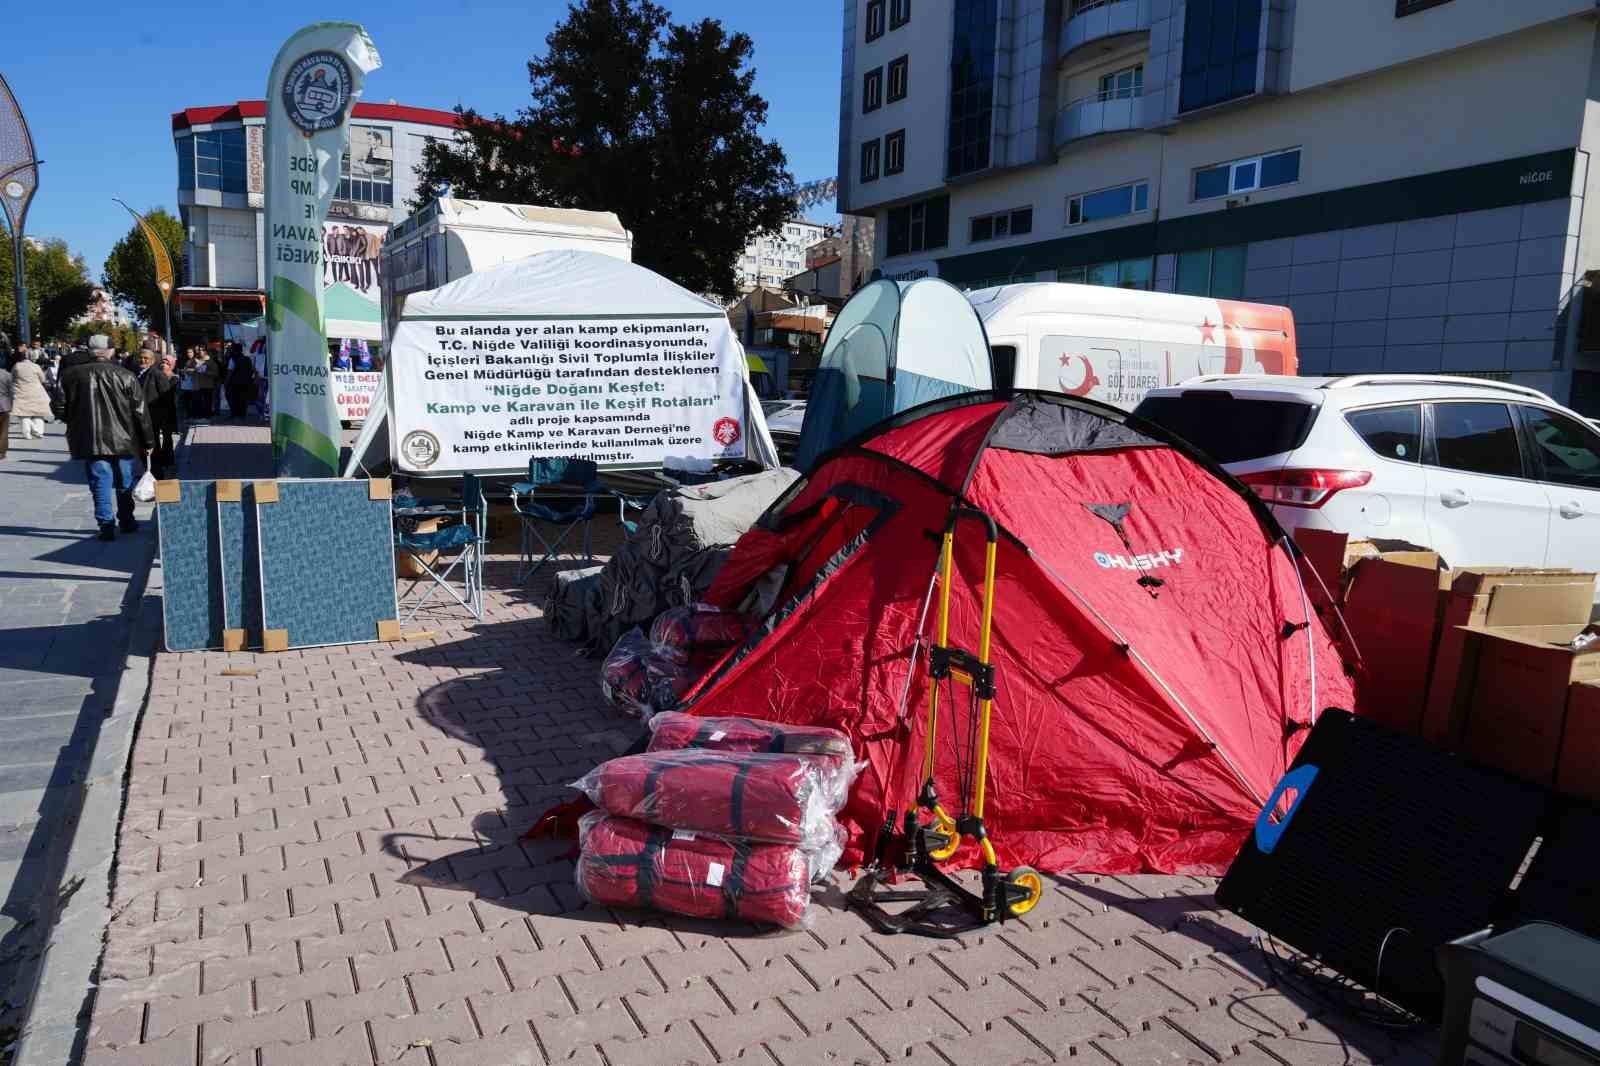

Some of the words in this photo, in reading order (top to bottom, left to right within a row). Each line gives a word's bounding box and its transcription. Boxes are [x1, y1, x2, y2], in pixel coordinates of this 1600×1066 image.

[435, 326, 455, 336] Bu
[460, 325, 510, 335] alanda
[516, 327, 538, 336] yer
[543, 325, 574, 334] alan
[579, 325, 618, 335] kamp
[622, 323, 709, 334] ekipmanları,
[439, 340, 467, 350] T.C.
[472, 340, 515, 352] Niğde
[520, 339, 570, 351] Valiliği
[575, 337, 708, 349] koordinasyonunda,
[428, 353, 479, 367] İçişleri
[485, 355, 554, 366] Bakanlığı
[559, 353, 589, 364] Sivil
[594, 352, 659, 364] Toplumla
[663, 350, 715, 363] İlişkiler
[425, 369, 468, 380] Genel
[474, 369, 551, 380] Müdürlüğü
[556, 367, 629, 378] tarafından
[634, 365, 720, 376] desteklenen
[547, 383, 603, 396] Doğanı
[608, 381, 665, 395] Keşfet:
[426, 403, 476, 415] Kamp
[482, 404, 501, 412] ve
[507, 401, 575, 412] Karavan
[581, 400, 600, 410] ile
[605, 398, 646, 411] Keşif
[510, 417, 533, 425] adlı
[538, 415, 570, 426] proje
[574, 413, 651, 424] kapsamında
[464, 430, 502, 440] Niğde
[507, 430, 544, 439] Kamp
[568, 427, 620, 436] Karavan
[625, 424, 691, 434] Derneği'ne
[453, 444, 490, 454] kamp
[494, 440, 587, 452] etkinliklerinde
[591, 438, 664, 448] kullanılmak
[668, 437, 702, 445] üzere
